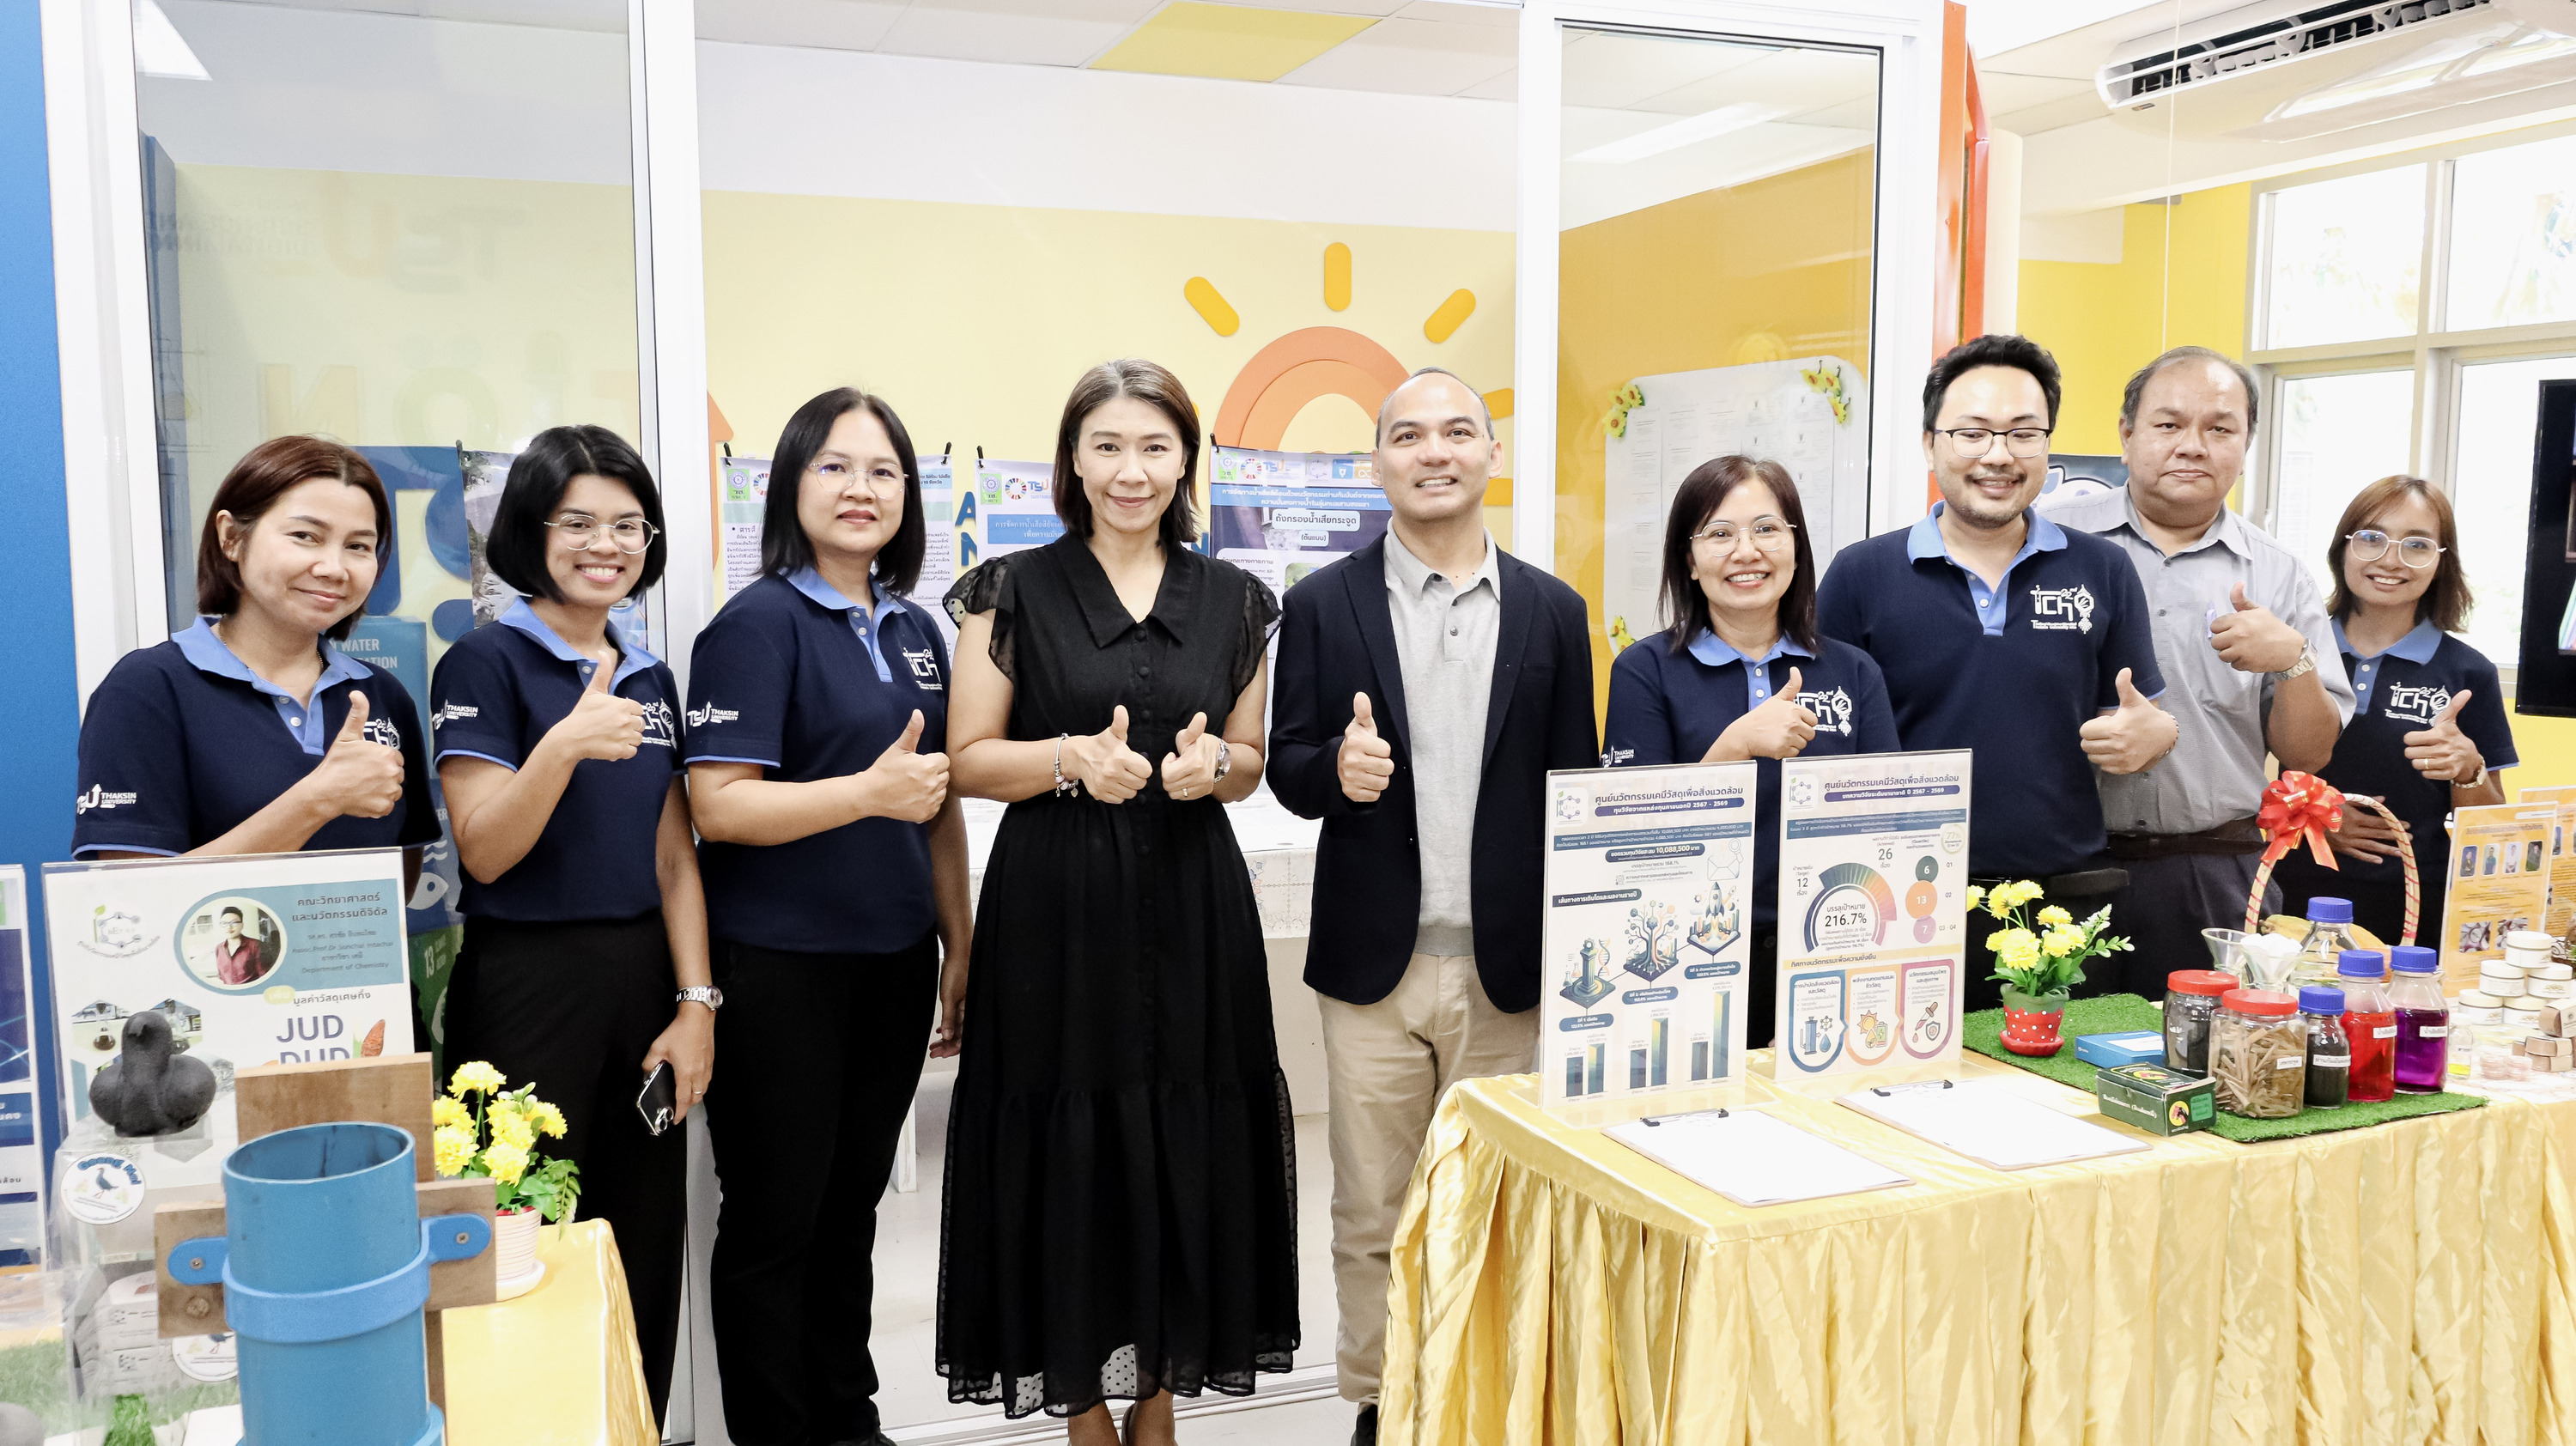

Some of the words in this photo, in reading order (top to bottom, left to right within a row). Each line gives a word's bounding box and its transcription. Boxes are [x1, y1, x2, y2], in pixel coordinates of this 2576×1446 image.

[1028, 478, 1049, 492] TSU
[1275, 512, 1358, 527] ถังกรองน้ำเสียกระจูด
[1301, 533, 1327, 542] (ต้นแบบ)
[342, 639, 380, 652] WATER
[687, 701, 712, 727] TSU
[1825, 774, 1959, 792] ศูนย์นวัตกรรมเคมีวัสดุเพื่อสิ่งแวดล้อม
[1595, 786, 1743, 805] ศูนย์นวัตกรรมเคมีวัสดุเพื่อสิ่งแวดล้อม
[1656, 845, 1691, 854] 10,088,500
[1878, 848, 1893, 860] 26
[1924, 866, 1930, 874] 6
[1797, 878, 1808, 888] 12
[297, 891, 381, 907] คณะวิทยาศาสตร์
[1917, 896, 1928, 905] 13
[1827, 903, 1866, 913] บรรลุเป้าหมาย
[1825, 913, 1867, 927] 216.7%
[1923, 926, 1928, 934] 7
[301, 964, 343, 975] Department
[355, 962, 389, 970] Chemistry
[423, 945, 434, 979] 13
[293, 988, 371, 1007] มูลค่าวัสดุเศษทิ้ง
[276, 1014, 344, 1043] JUD
